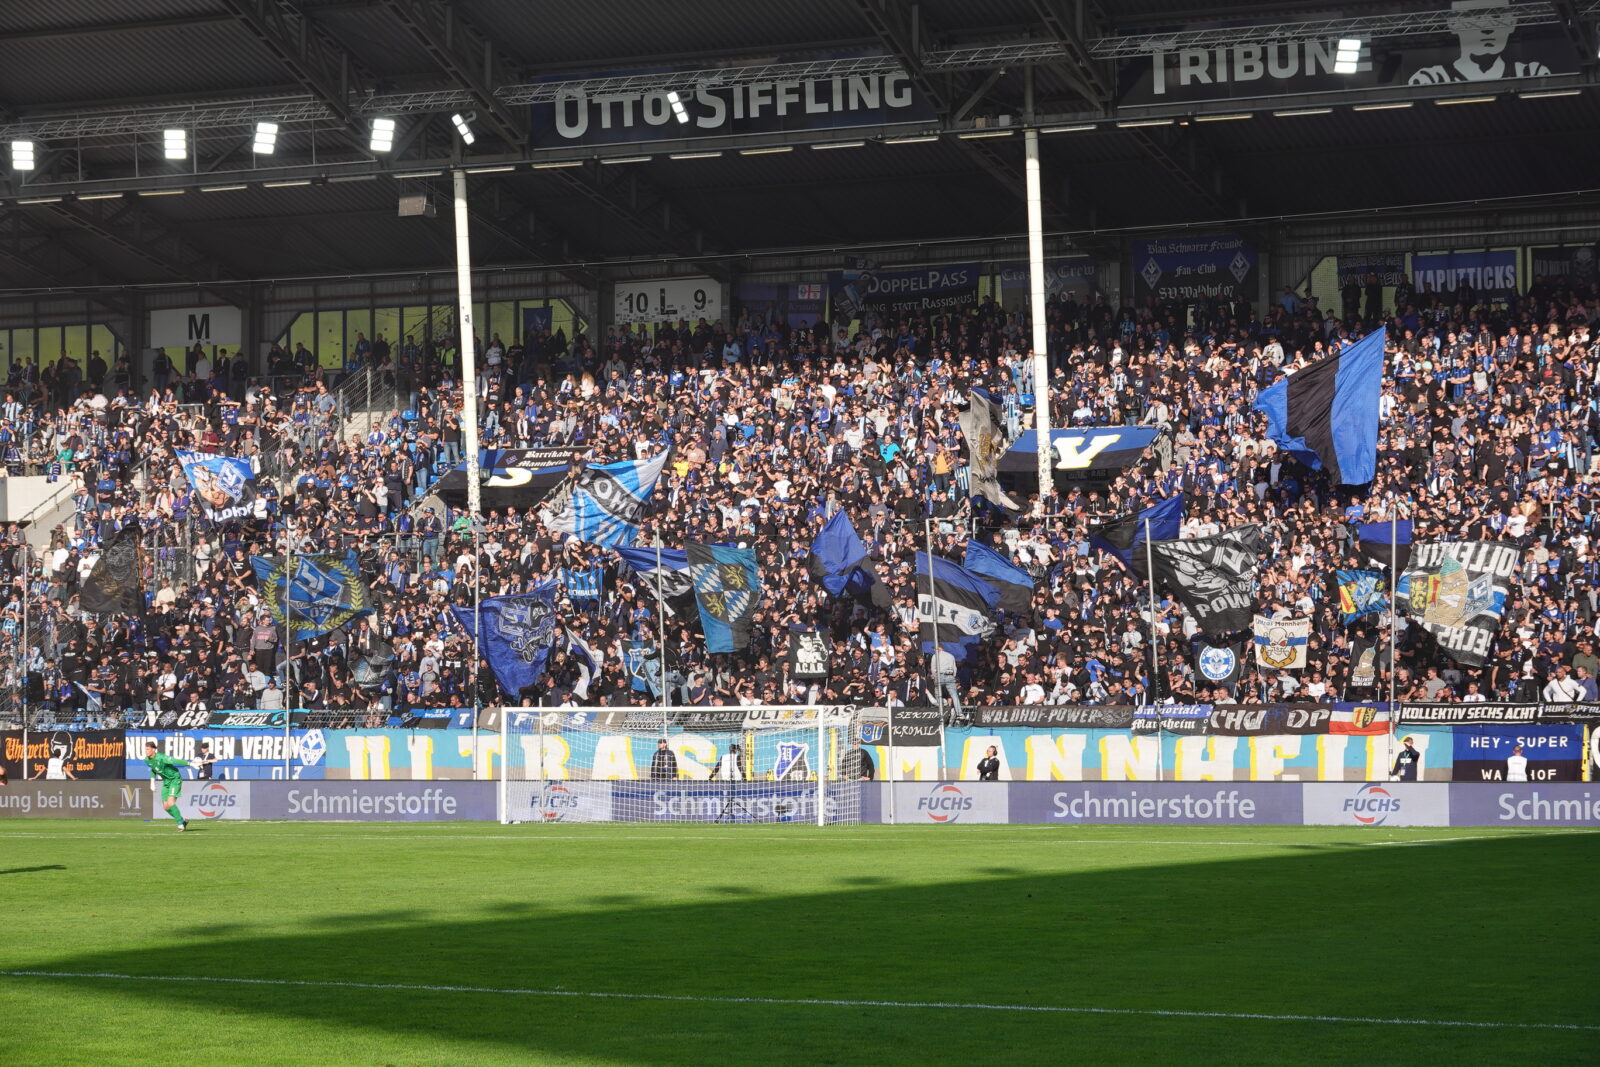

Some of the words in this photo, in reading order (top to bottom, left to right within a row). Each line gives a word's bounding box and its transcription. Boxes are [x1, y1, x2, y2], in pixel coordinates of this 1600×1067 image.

[555, 86, 671, 138] OTTO
[696, 72, 913, 128] SIFFLING
[1175, 265, 1191, 277] Fan
[1197, 264, 1216, 274] Club
[1415, 265, 1515, 293] KAPUTTICKS
[625, 292, 648, 313] 10
[660, 288, 677, 315] L
[694, 289, 706, 310] 9
[188, 314, 210, 340] M
[516, 459, 567, 467] Mannheim
[523, 450, 573, 459] Barrikade
[140, 710, 161, 727] N
[176, 710, 209, 727] 68
[1401, 706, 1465, 720] KOLLEKTIV
[1467, 706, 1504, 719] SECHS
[1504, 706, 1537, 719] ACHT
[73, 737, 124, 761] Mannheim
[126, 736, 158, 760] NU
[165, 732, 195, 760] FÜR
[242, 735, 300, 760] VEREIN
[1470, 736, 1501, 748] HEY
[1517, 736, 1568, 748] SUPER
[1481, 768, 1557, 780] WAHOF
[37, 790, 63, 808] bei
[69, 793, 104, 809] uns.
[190, 794, 236, 807] FUCHS
[287, 788, 457, 814] Schmierstoffe
[531, 795, 578, 808] FUCHS
[653, 790, 837, 816] Schmierstoffe
[917, 796, 973, 810] FUCHS
[1053, 790, 1256, 819] Schmierstoffe
[1342, 798, 1401, 812] FUCHS
